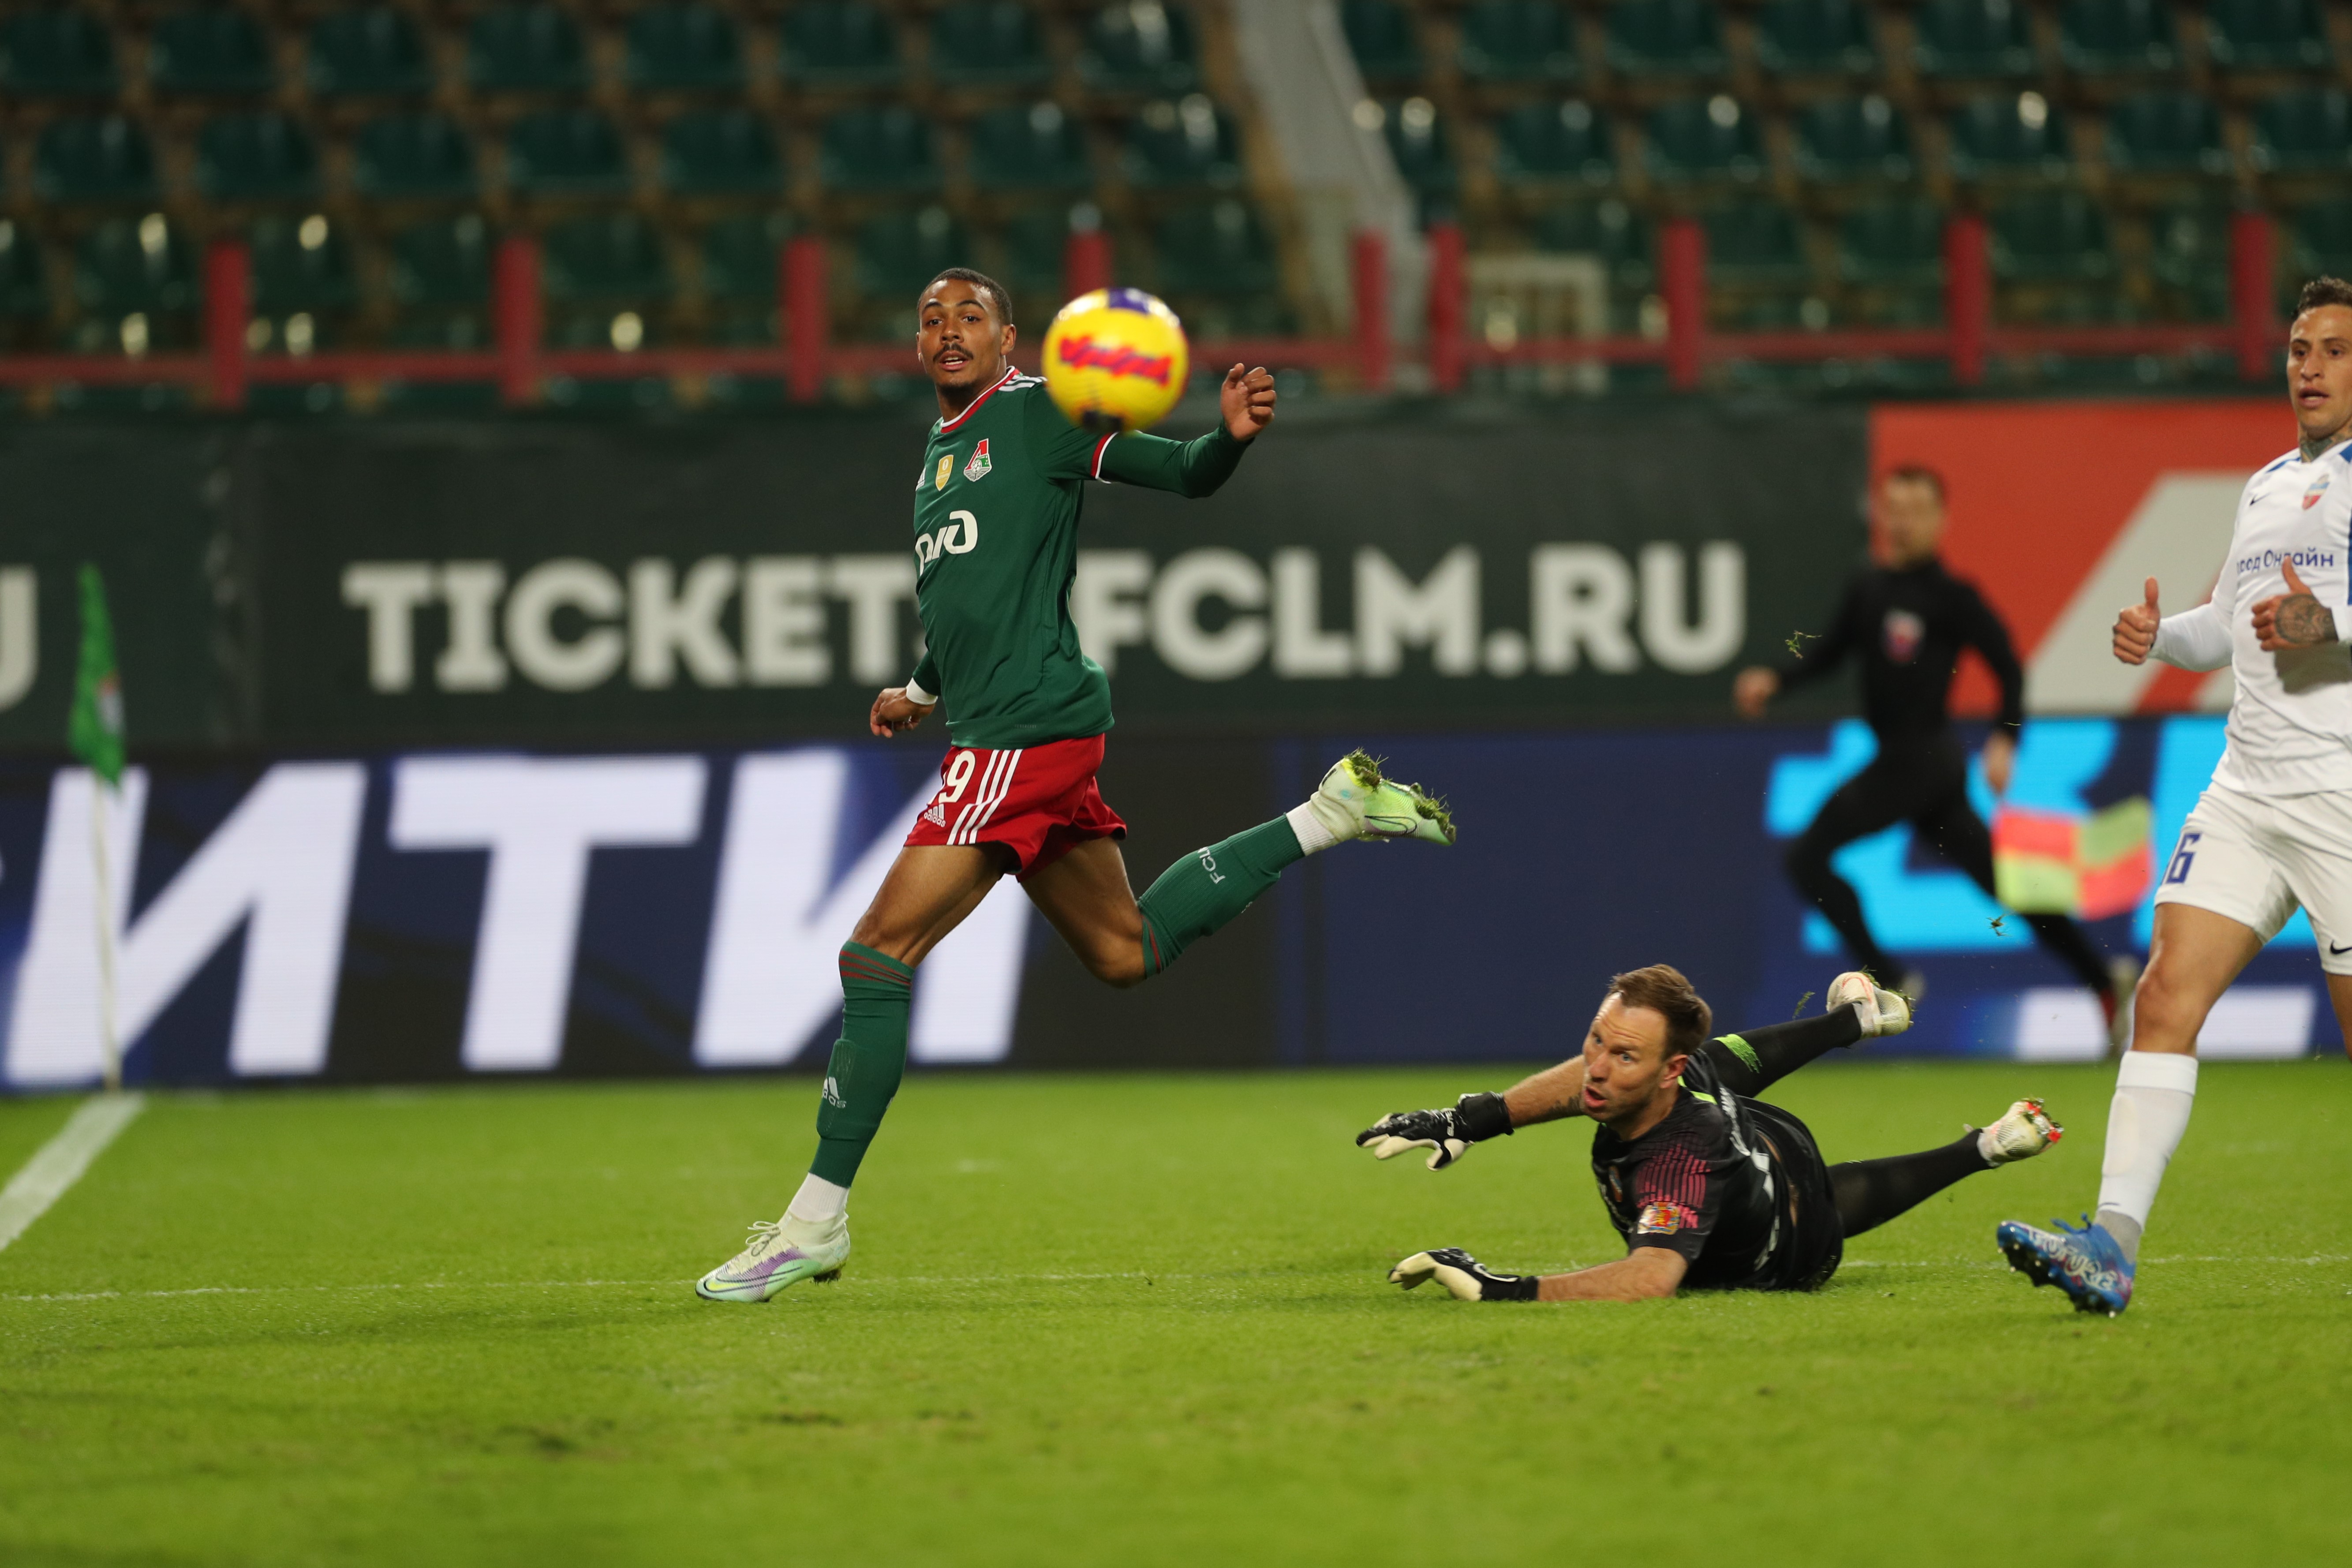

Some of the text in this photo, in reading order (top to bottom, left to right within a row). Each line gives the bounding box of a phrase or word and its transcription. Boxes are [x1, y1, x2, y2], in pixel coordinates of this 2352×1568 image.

[927, 750, 976, 805] 9
[924, 812, 946, 827] adidas
[2166, 833, 2201, 883] 6
